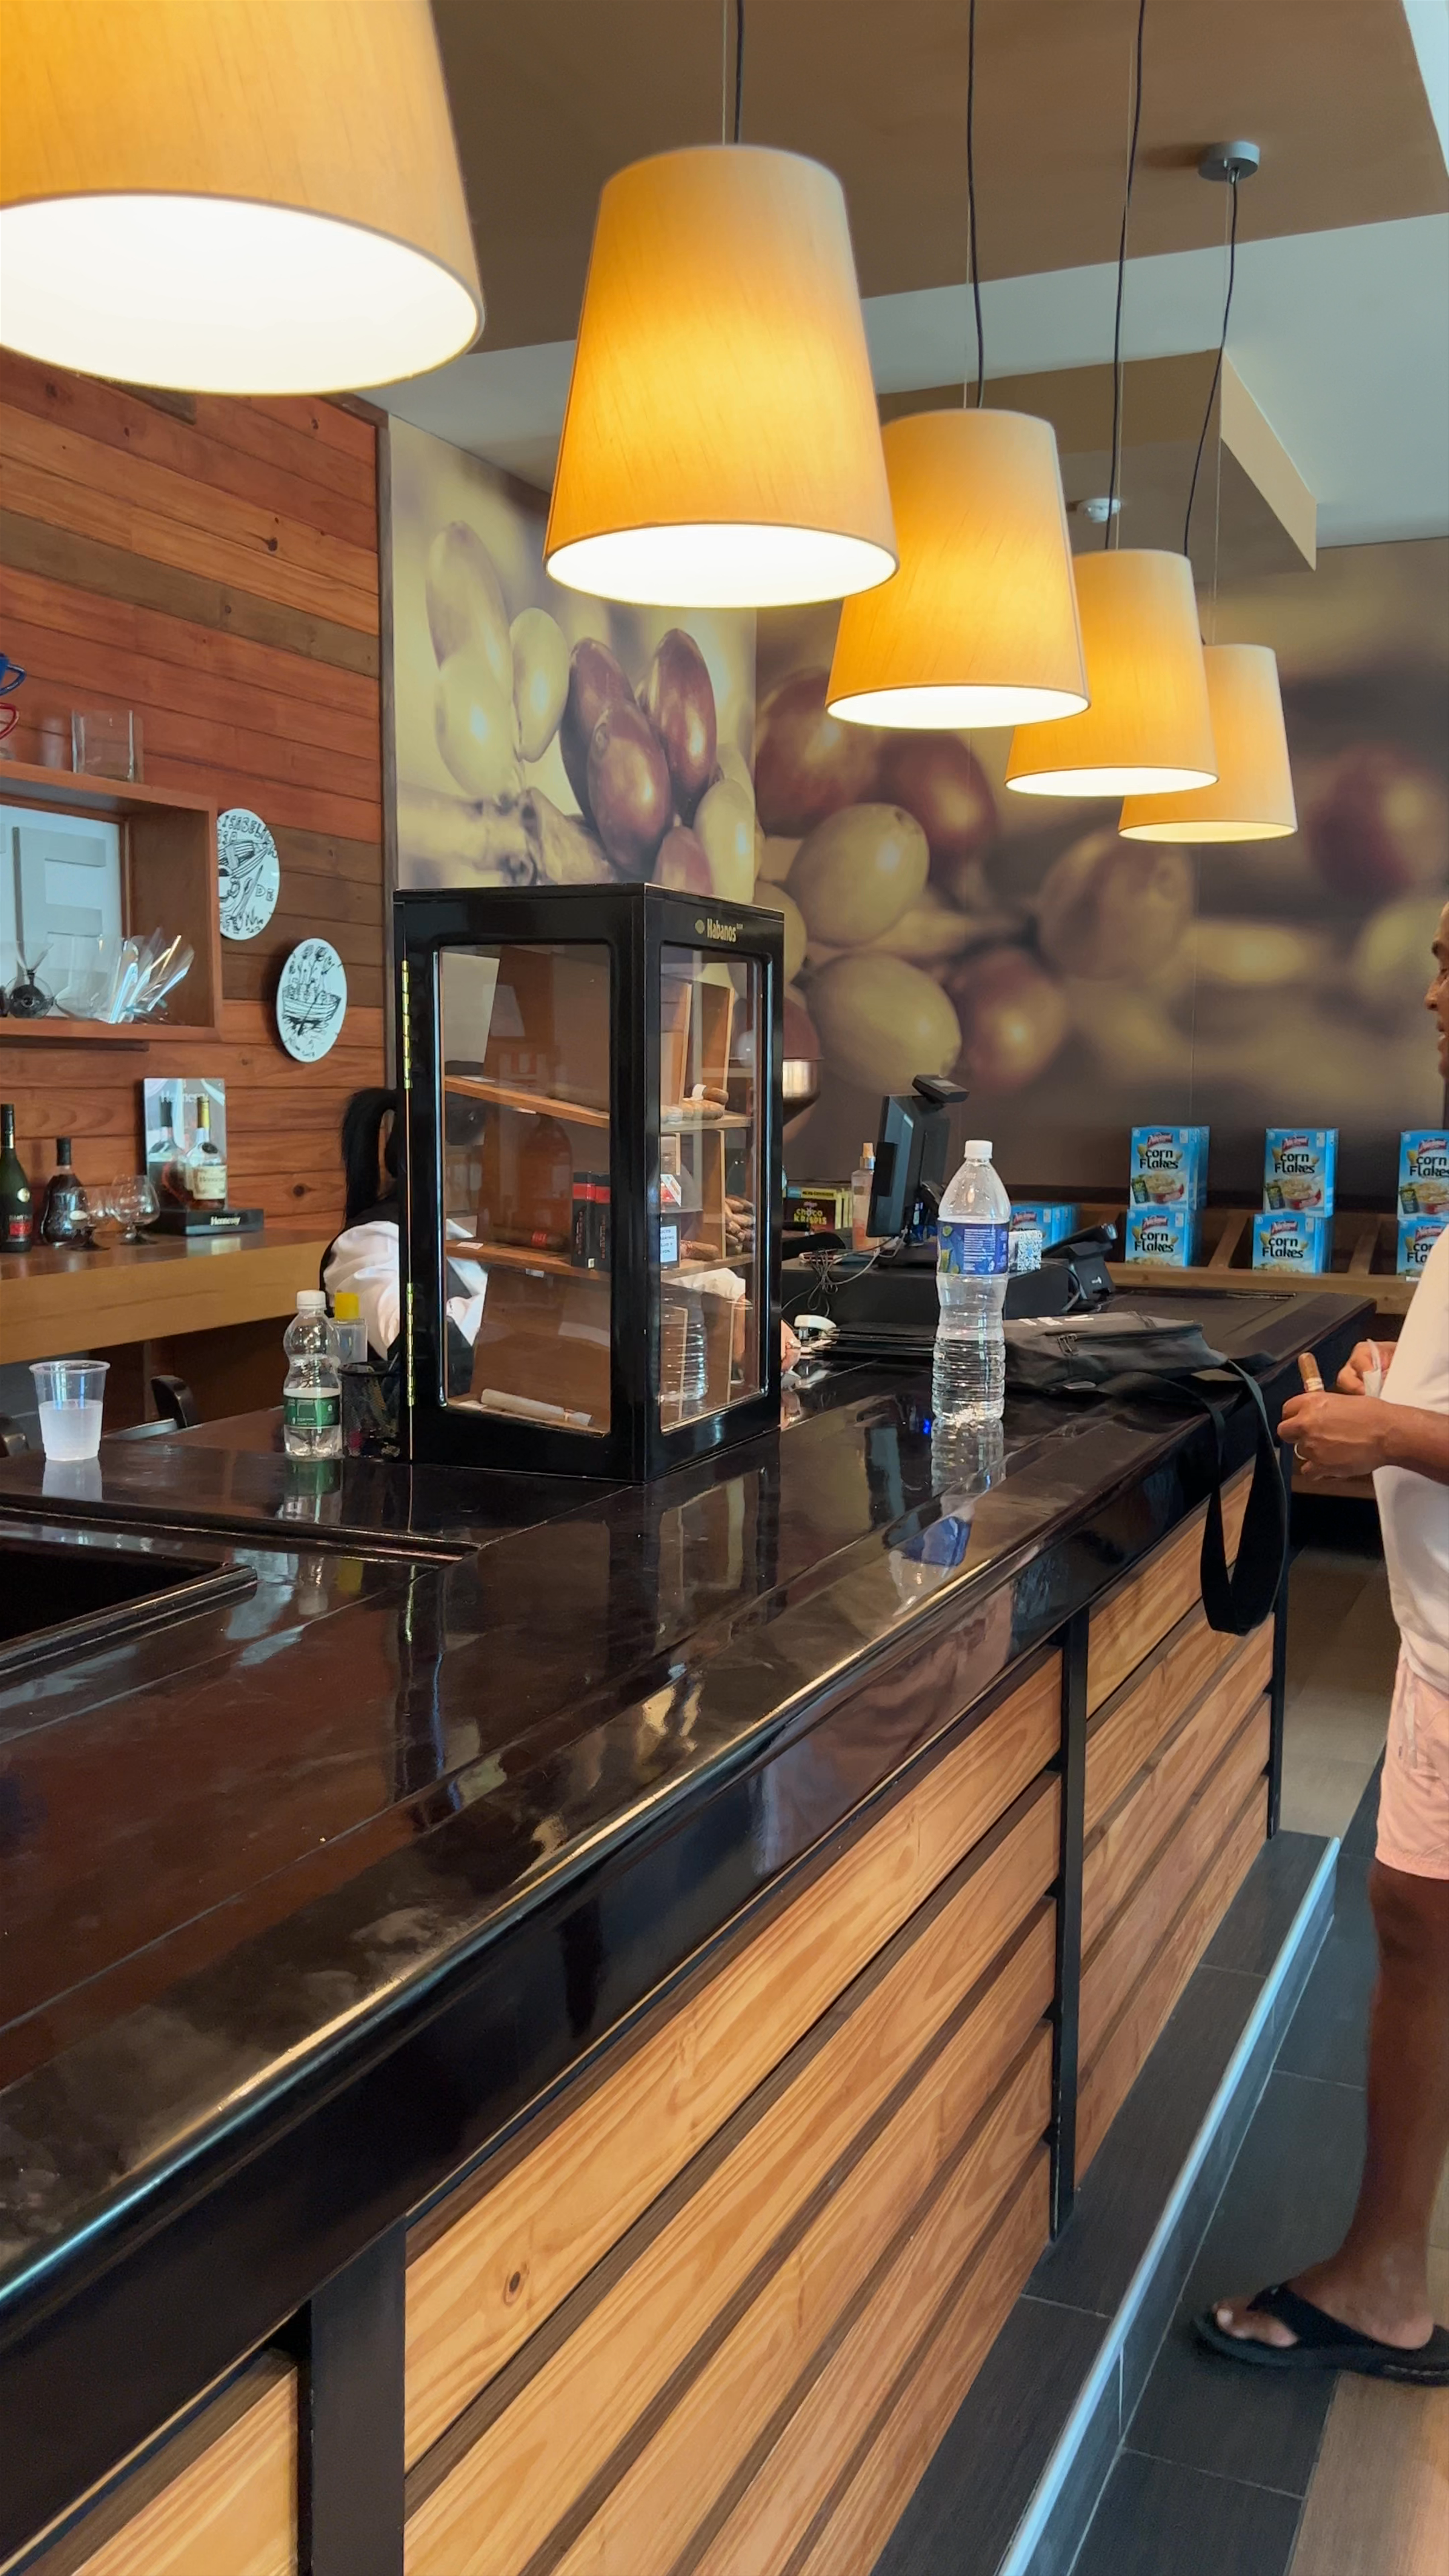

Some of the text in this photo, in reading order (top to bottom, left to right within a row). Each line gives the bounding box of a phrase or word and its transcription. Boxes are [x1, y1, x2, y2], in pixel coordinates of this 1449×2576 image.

[707, 918, 737, 943] Habanos
[1146, 1149, 1173, 1158] corn
[1280, 1152, 1309, 1163] corn
[1140, 1158, 1179, 1169] Flakes
[1416, 1156, 1447, 1166] corn
[1274, 1162, 1315, 1174] Flakes
[1140, 1232, 1168, 1241] corn
[1268, 1237, 1298, 1247] corn
[1134, 1240, 1174, 1253] Flakes
[1262, 1246, 1303, 1258] Flakes
[1413, 1243, 1434, 1252] cor
